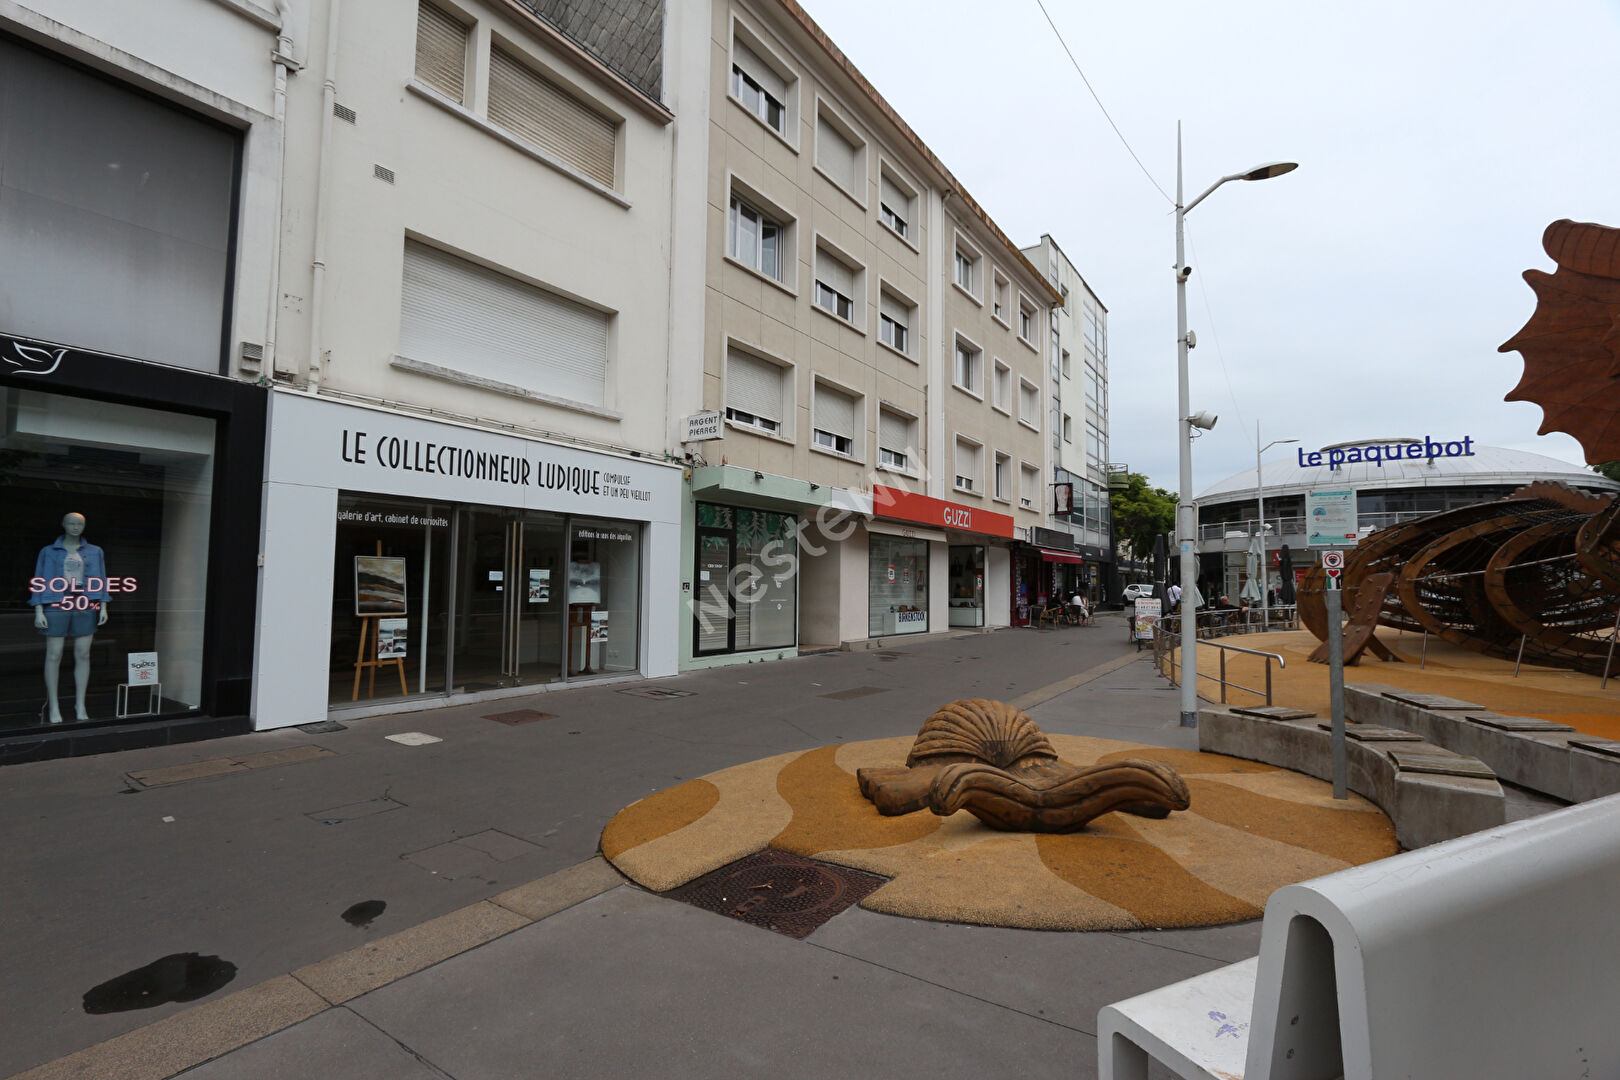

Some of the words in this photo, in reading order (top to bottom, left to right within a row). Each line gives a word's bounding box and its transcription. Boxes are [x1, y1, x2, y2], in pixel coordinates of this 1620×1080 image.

[689, 415, 718, 427] ARGENT
[688, 425, 718, 436] PIERRES
[1298, 447, 1322, 468] le
[1329, 435, 1476, 471] paquebot
[342, 429, 367, 465] LE
[376, 435, 531, 487] COLLECTIONNEUR
[538, 462, 601, 496] LUDIQUE
[603, 472, 631, 486] COMPULSIF
[603, 485, 609, 496] ET
[610, 486, 619, 498] UN
[619, 487, 630, 499] PEU
[337, 510, 363, 521] galerie
[384, 513, 409, 524] cabinet
[410, 515, 419, 525] de
[29, 576, 138, 593] SOLDES
[50, 595, 101, 611] -50%
